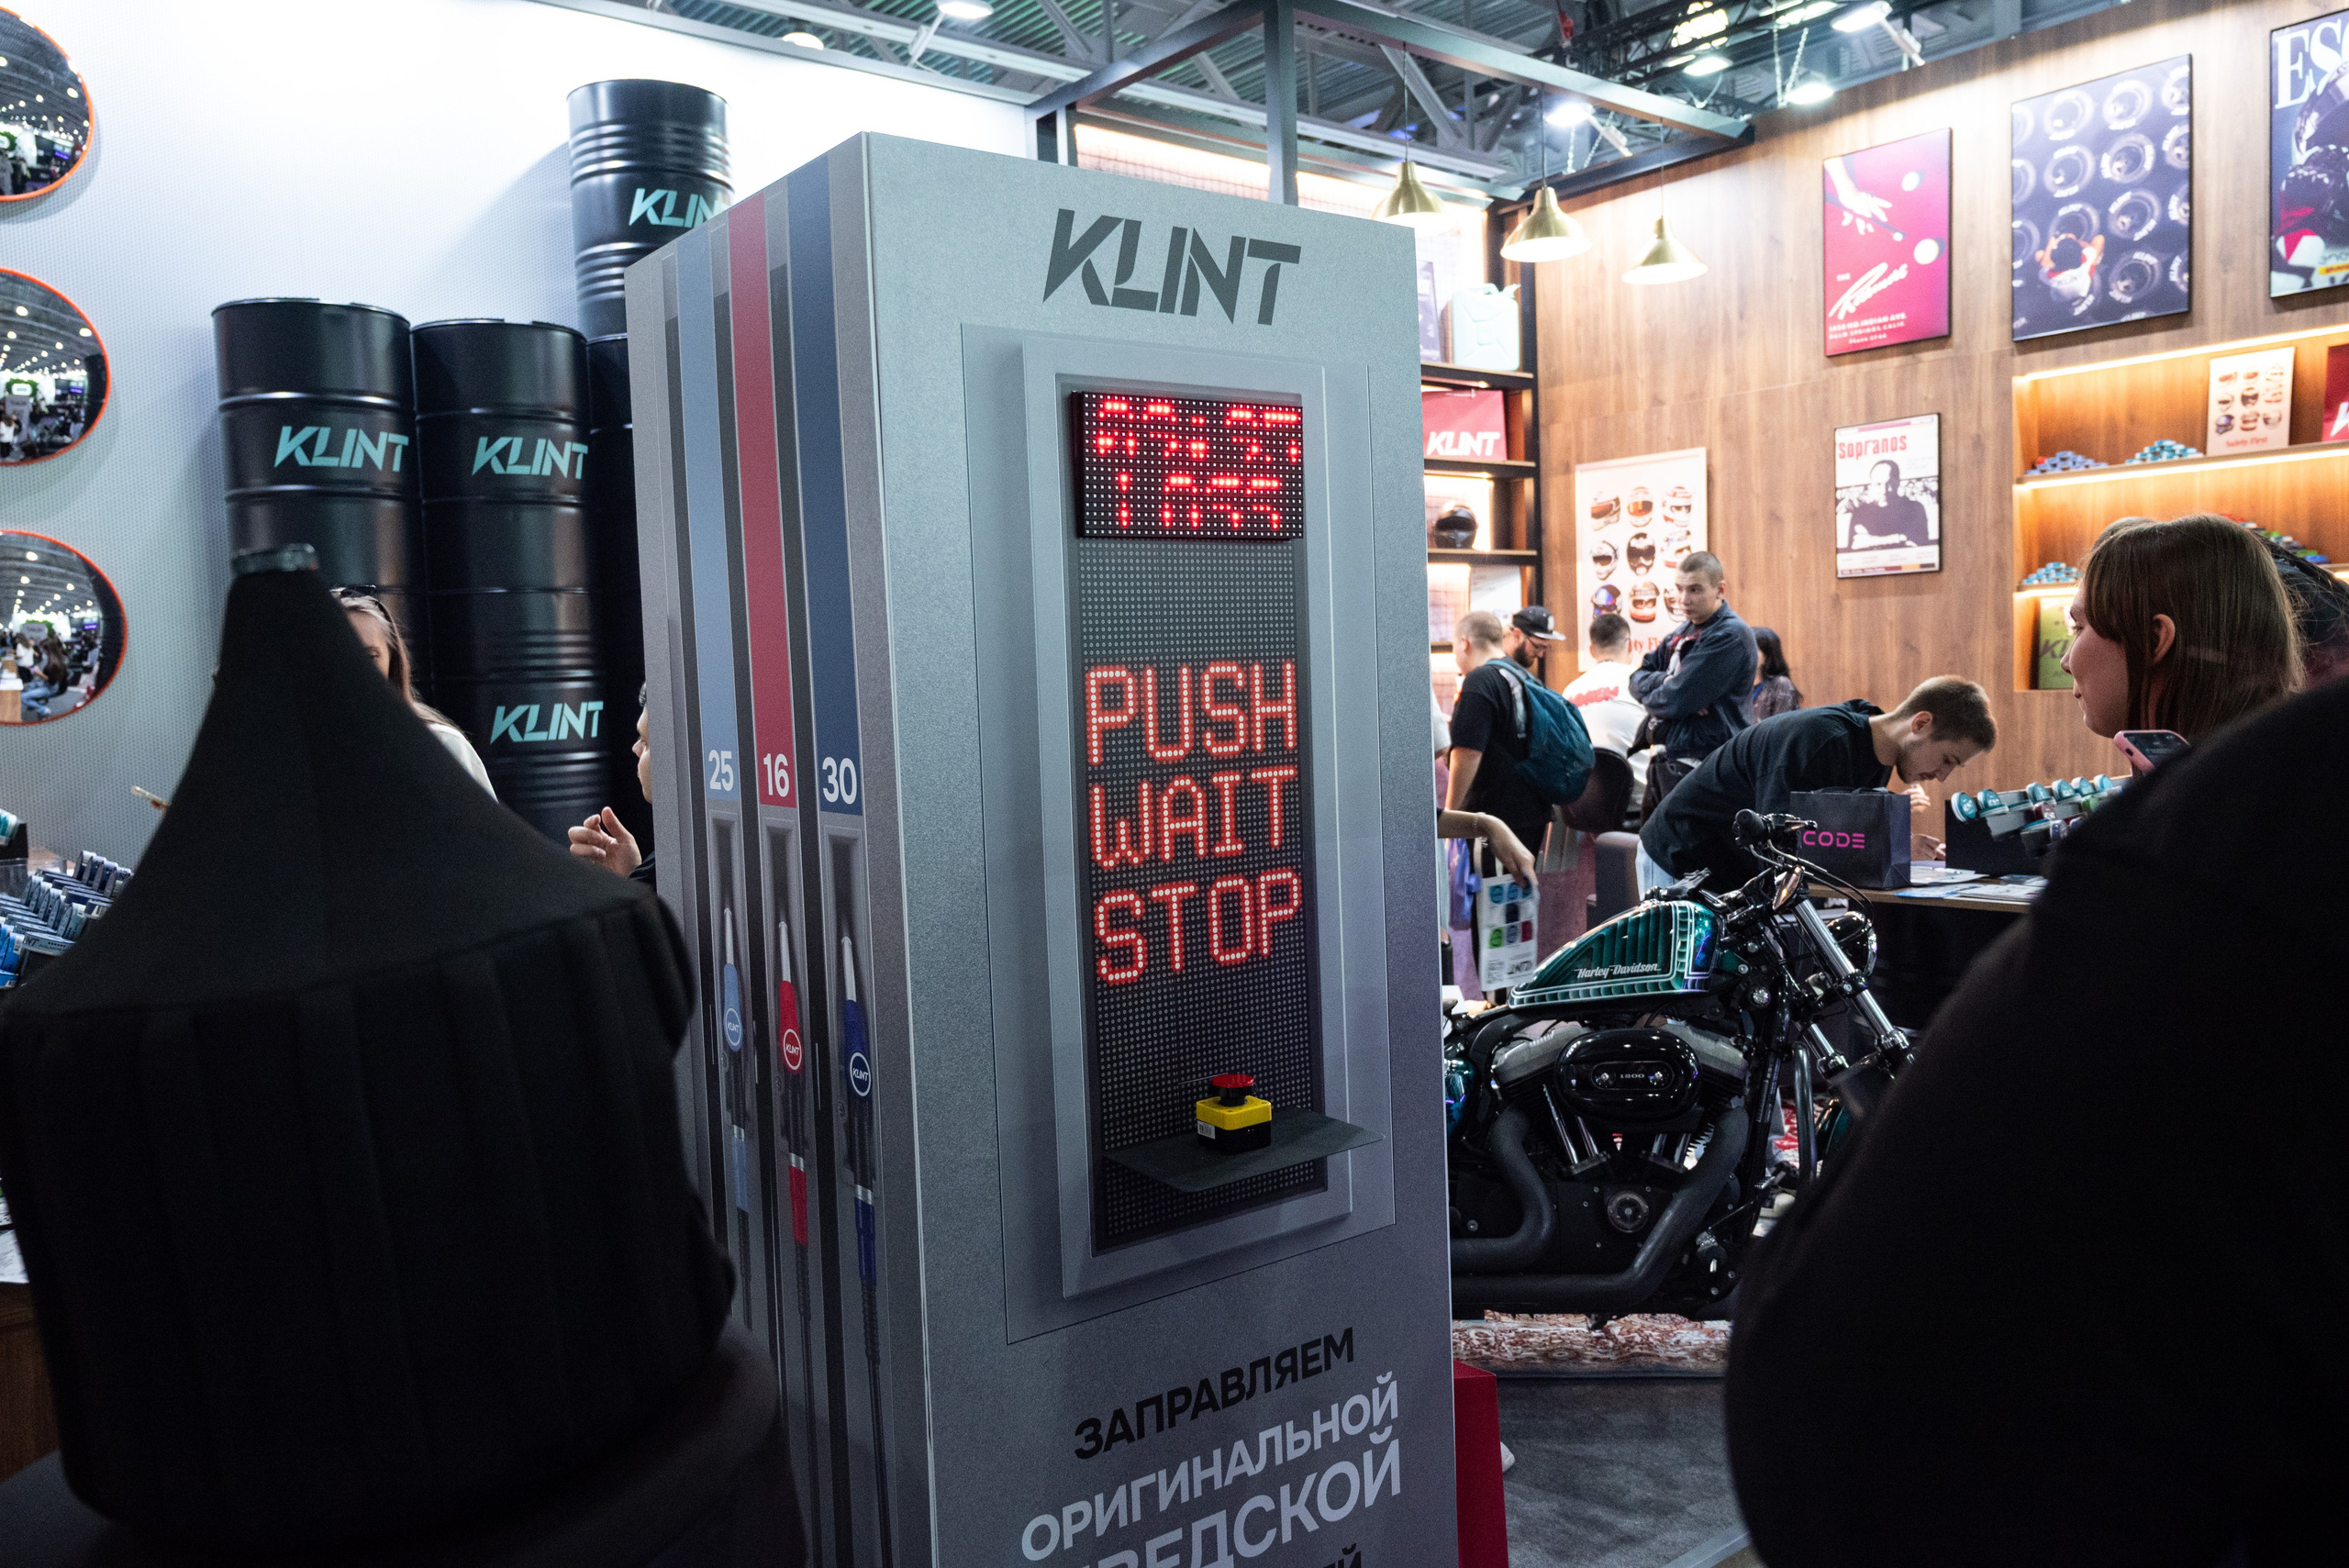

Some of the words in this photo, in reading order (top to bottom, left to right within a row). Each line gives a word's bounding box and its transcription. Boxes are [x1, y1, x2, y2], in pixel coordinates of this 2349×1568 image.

[629, 187, 725, 228] KLIN
[1042, 208, 1301, 326] KLINT
[274, 426, 409, 472] KLINT
[472, 437, 588, 480] KLINT
[1427, 431, 1500, 456] KLINT
[490, 701, 604, 745] KLINT
[1086, 661, 1297, 765] PUSH
[708, 750, 733, 791] 25
[763, 753, 790, 797] 16
[822, 757, 857, 804] 30
[1091, 765, 1297, 869] WAIT
[1803, 830, 1865, 849] CODE
[1095, 867, 1301, 984] STOP
[728, 1022, 740, 1033] KLINT
[786, 1043, 800, 1055] KLINT
[853, 1068, 869, 1081] KLINT
[1074, 1327, 1354, 1460] ЗАПРАВЛЯЕМ
[1021, 1371, 1398, 1561] ОРИГИНАЛЬНОЙ
[1080, 1424, 1401, 1568] ЕДСКОЙ
